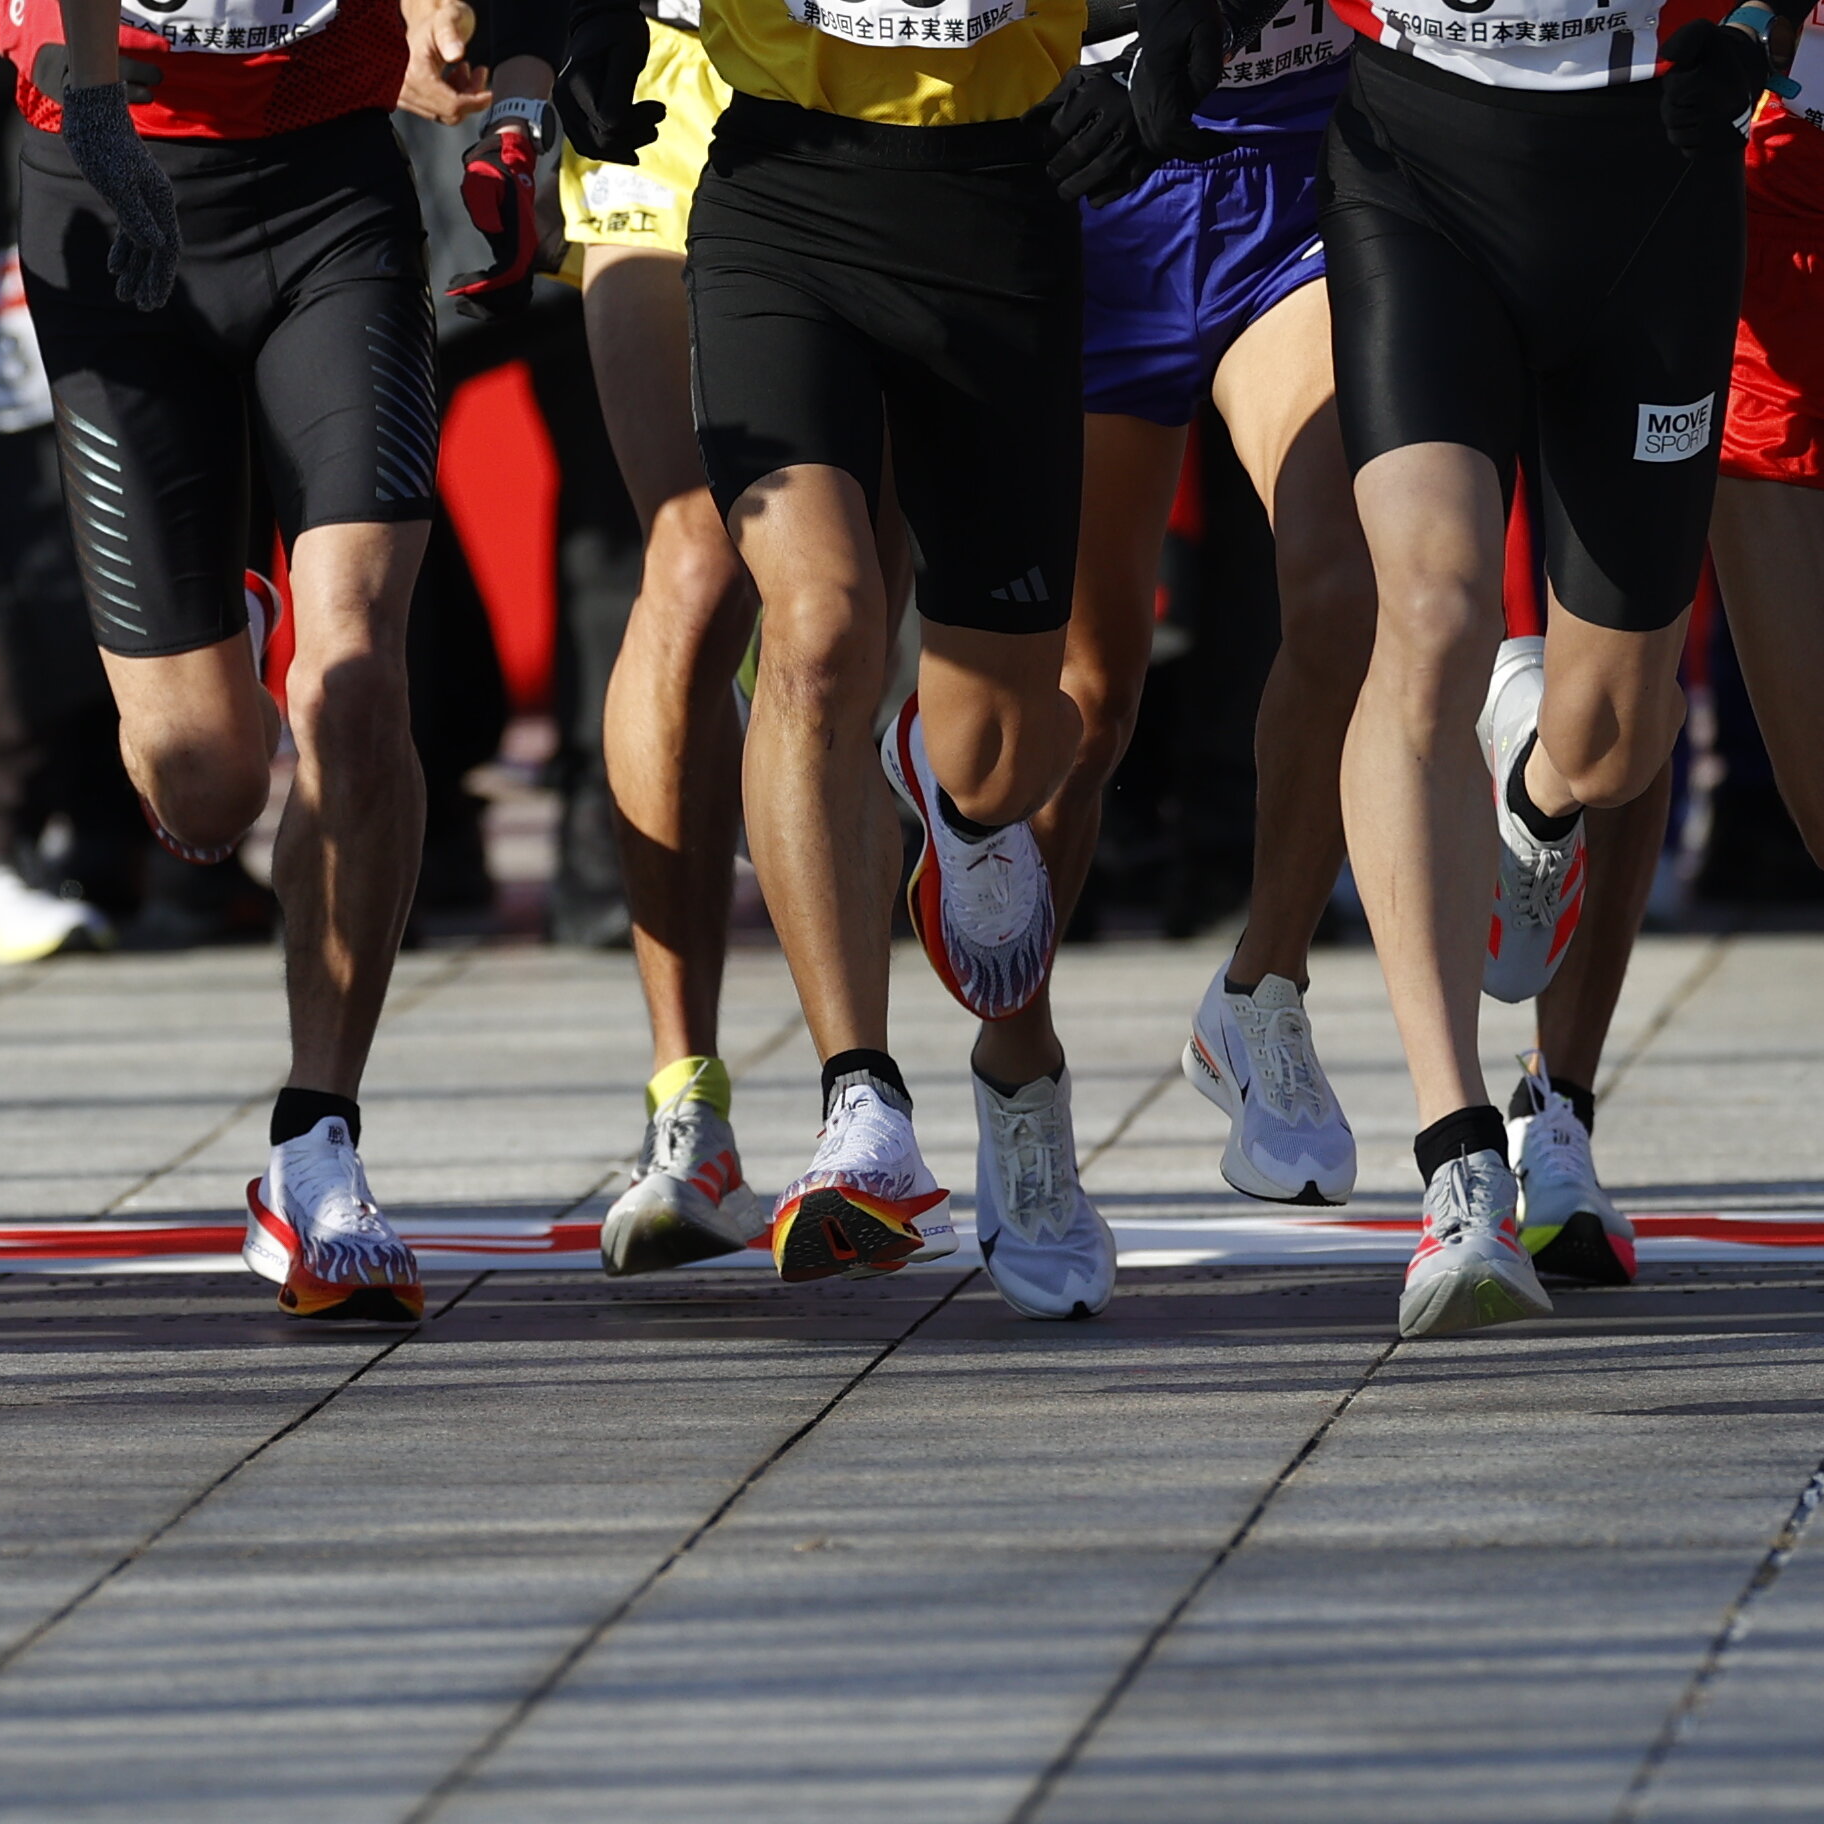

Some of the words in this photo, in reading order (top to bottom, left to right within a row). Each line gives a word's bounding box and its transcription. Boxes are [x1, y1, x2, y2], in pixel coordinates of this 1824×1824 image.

[1382, 12, 1628, 43] 69回全日本実業団駅伝
[1648, 404, 1709, 434] MOVE
[1644, 425, 1706, 454] SPORT
